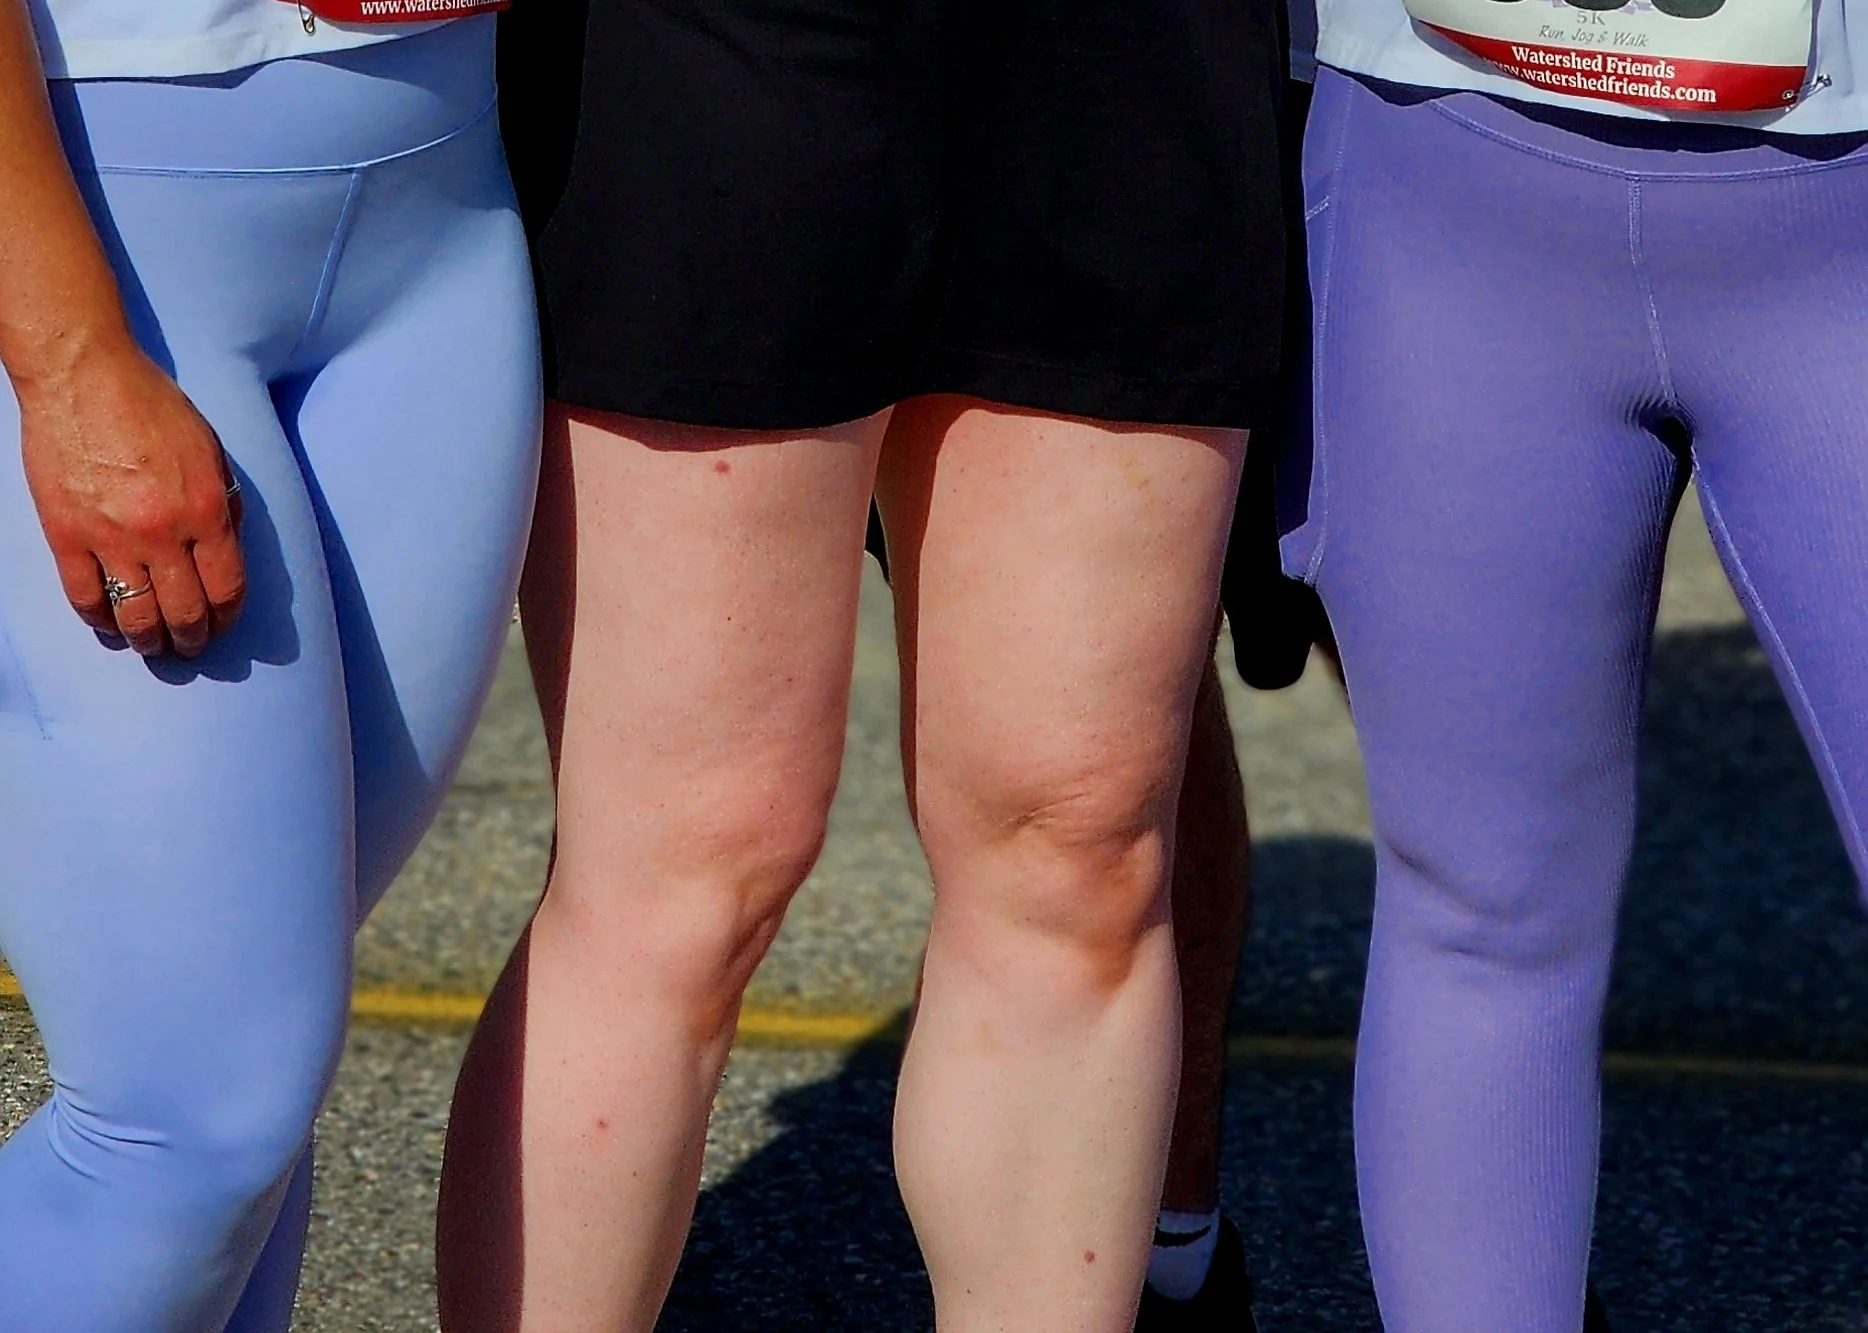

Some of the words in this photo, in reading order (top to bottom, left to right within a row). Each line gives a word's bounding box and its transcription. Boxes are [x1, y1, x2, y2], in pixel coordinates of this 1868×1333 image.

[1571, 28, 1594, 44] Jog
[1613, 31, 1650, 47] Walk
[1511, 46, 1602, 71] Watershed
[1606, 56, 1675, 79] Friends
[1482, 57, 1717, 103] ww.watershedfriends.com
